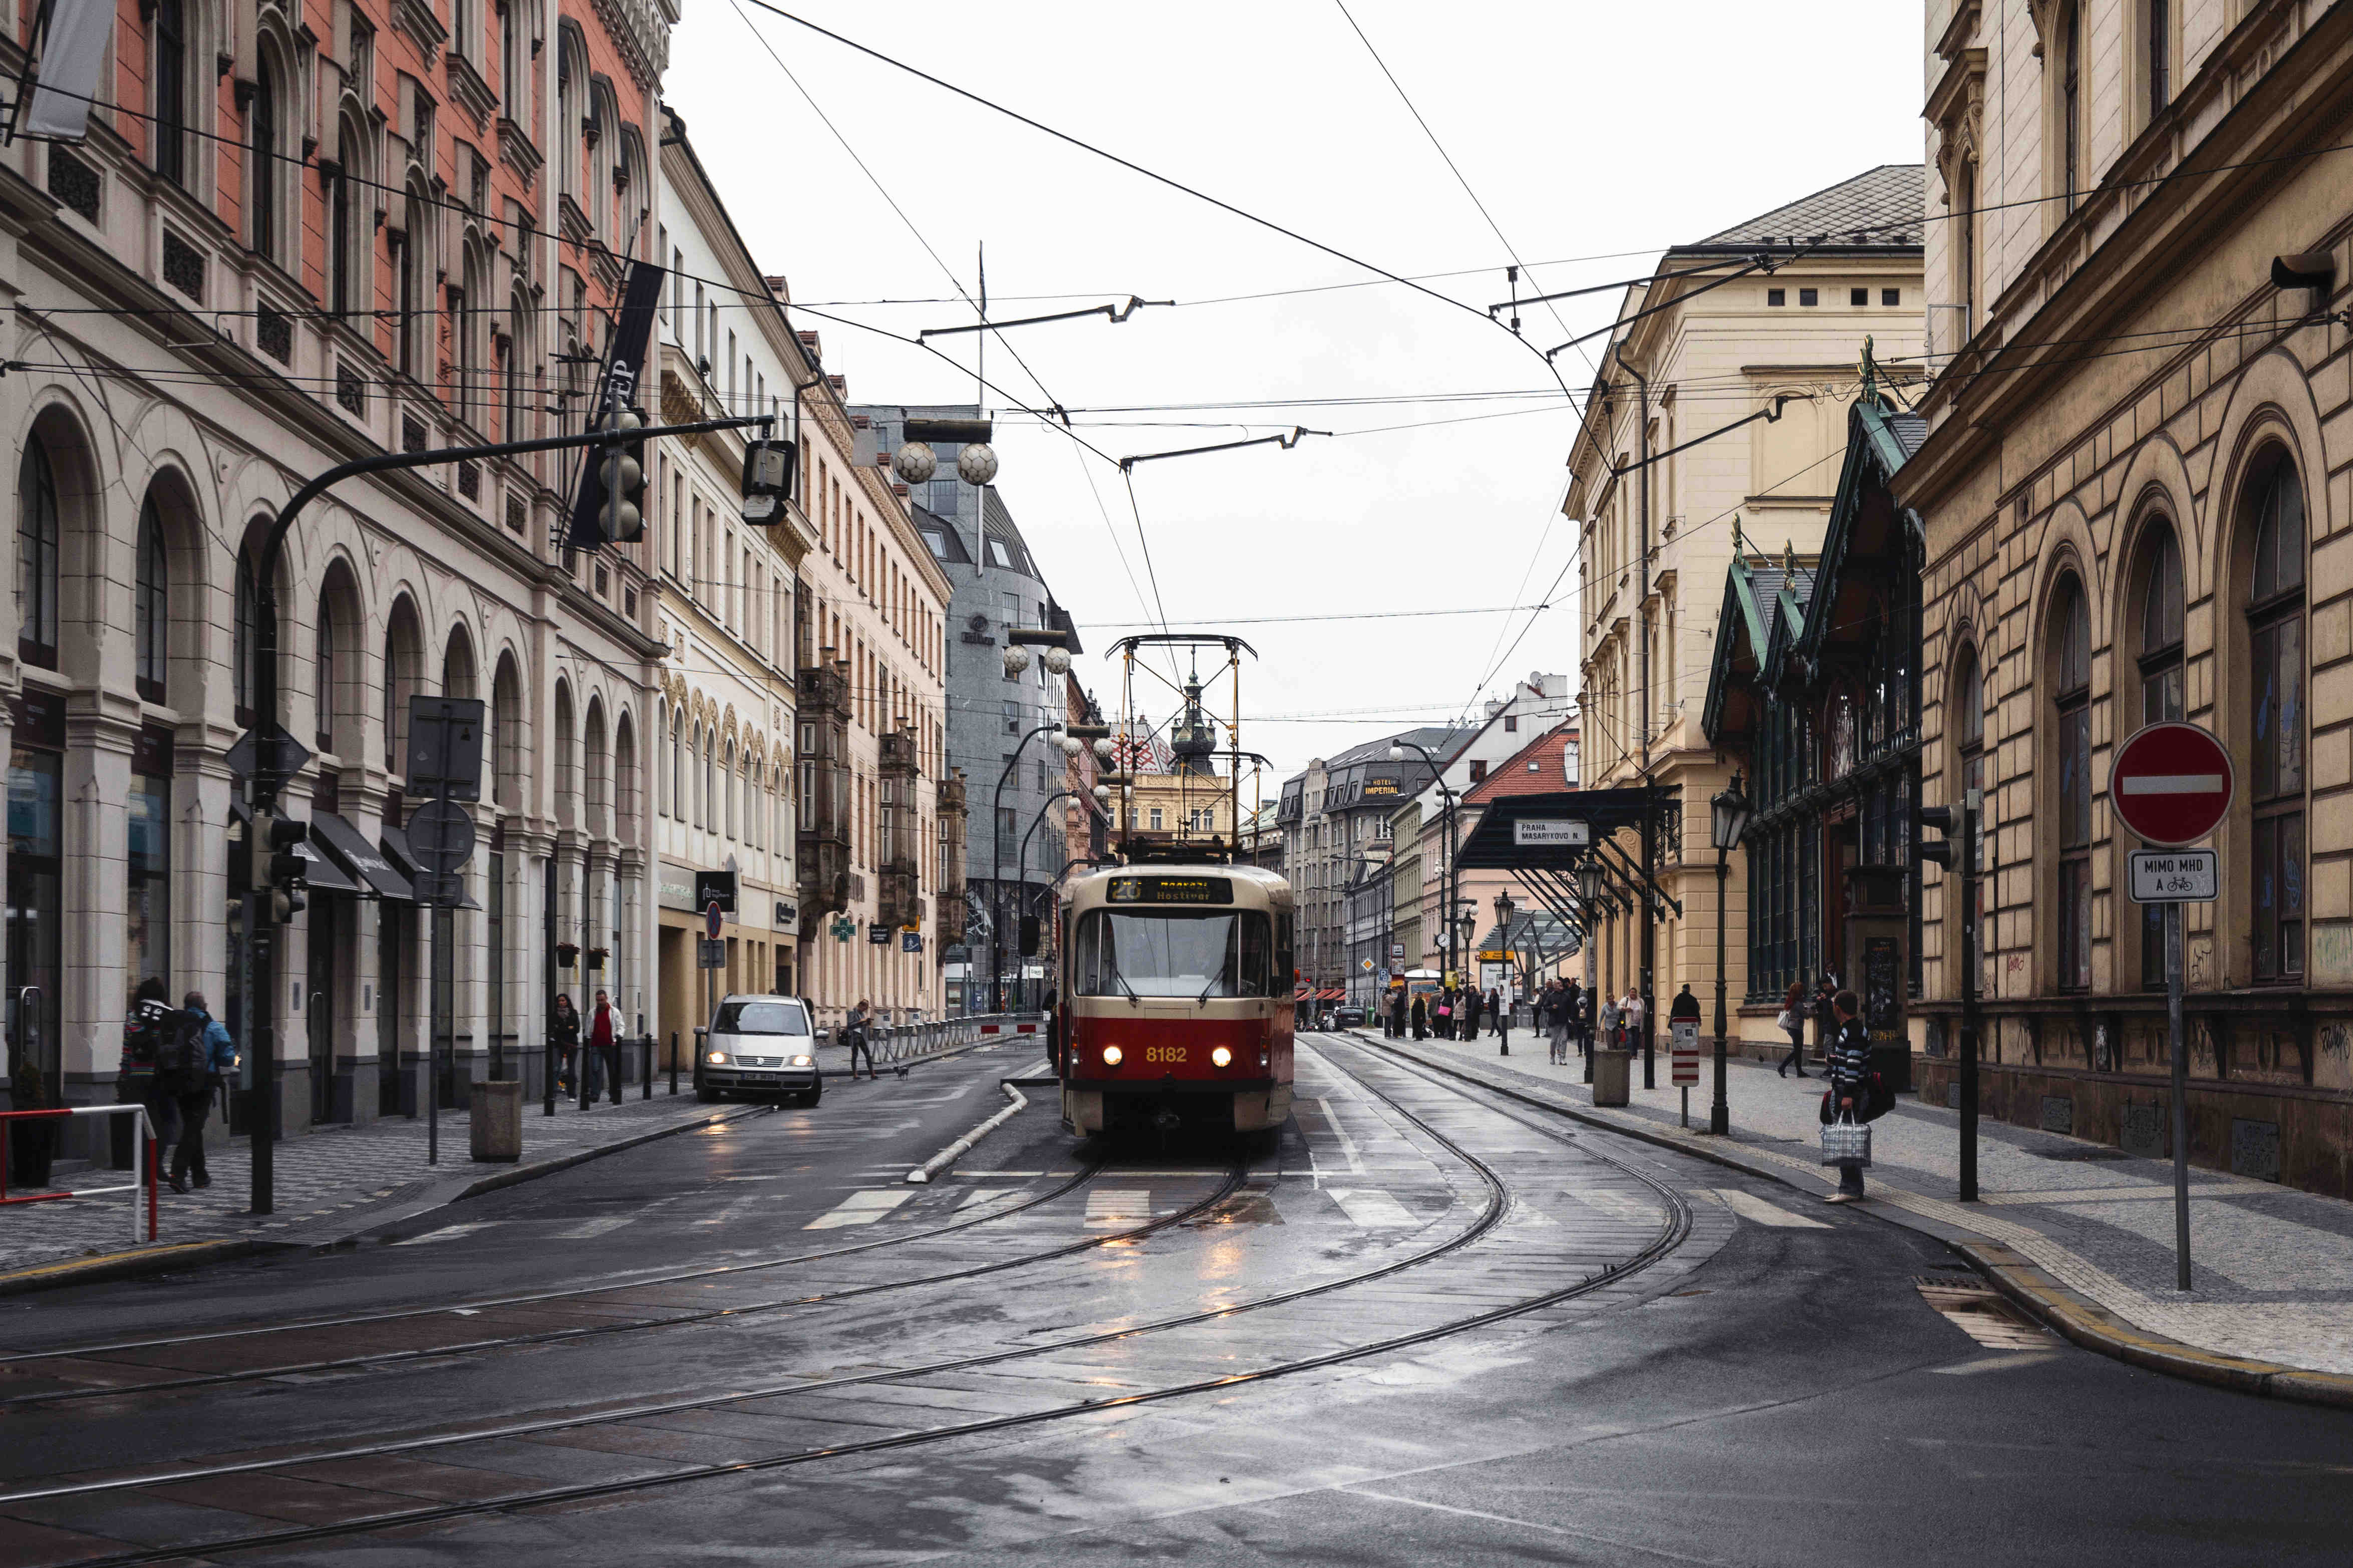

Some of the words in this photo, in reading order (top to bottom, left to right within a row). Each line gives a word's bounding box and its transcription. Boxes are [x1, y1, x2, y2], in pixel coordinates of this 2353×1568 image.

[1365, 786, 1398, 794] IMPERIAL
[2145, 859, 2174, 873] MIMO
[2179, 859, 2203, 872] MHD
[2156, 878, 2164, 891] A
[1146, 1047, 1187, 1062] 8182
